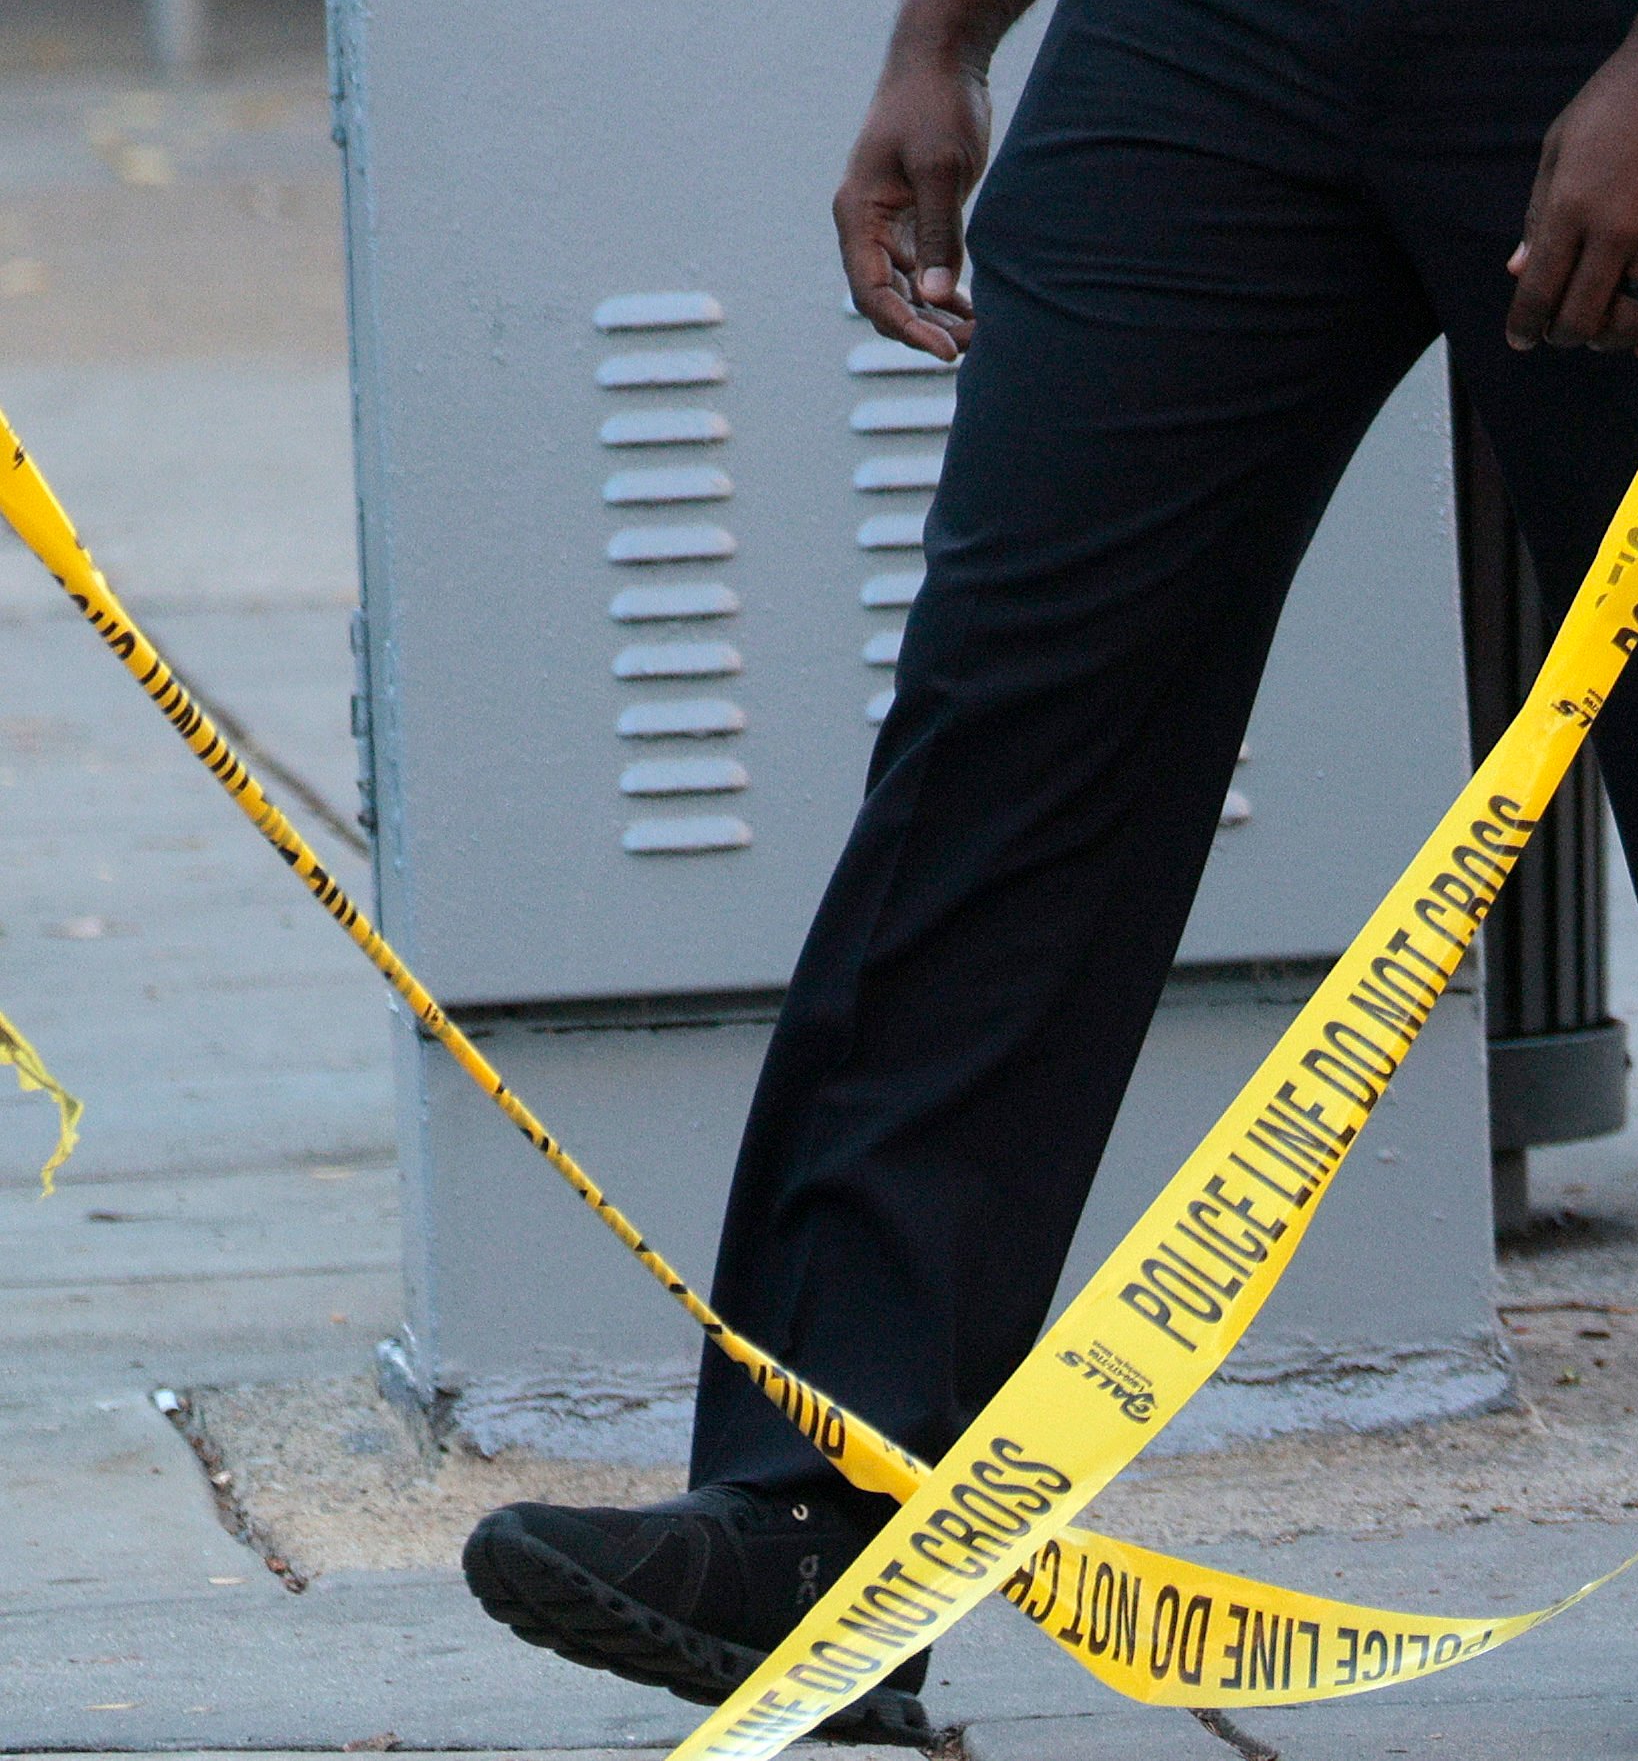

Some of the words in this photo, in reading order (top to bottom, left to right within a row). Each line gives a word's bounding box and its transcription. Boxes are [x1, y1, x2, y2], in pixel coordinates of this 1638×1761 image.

[1412, 793, 1538, 952] CROSS
[1346, 926, 1450, 1046] NOT
[1299, 1020, 1398, 1112] DO
[1227, 1080, 1357, 1211] LINE
[1118, 1174, 1289, 1354] POLICE
[1055, 1350, 1158, 1425] GALLS
[785, 1639, 881, 1696] DO
[837, 1558, 959, 1650] NOT
[909, 1436, 1072, 1581] CROSS
[1058, 1554, 1143, 1667] NOT
[1149, 1584, 1213, 1687] DO
[1220, 1602, 1321, 1692] LINE
[1334, 1626, 1494, 1687] POLICE
